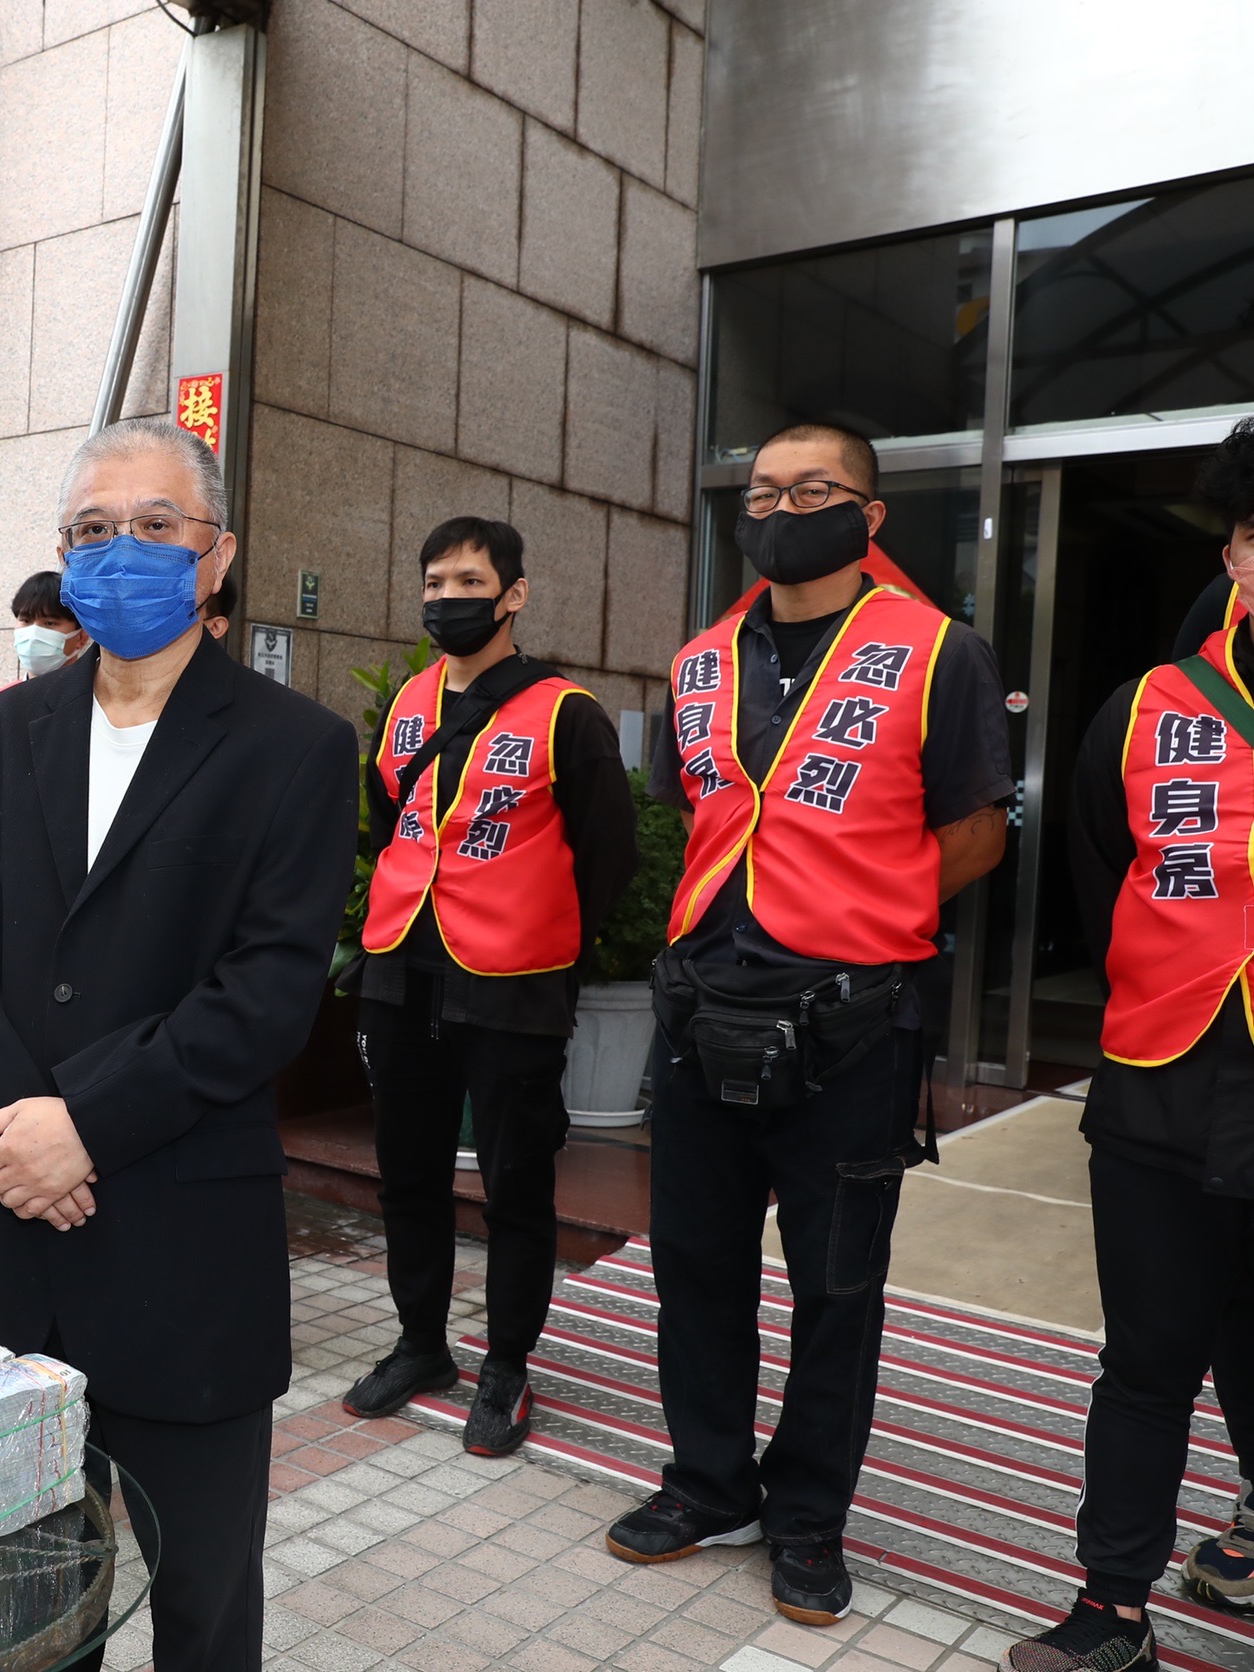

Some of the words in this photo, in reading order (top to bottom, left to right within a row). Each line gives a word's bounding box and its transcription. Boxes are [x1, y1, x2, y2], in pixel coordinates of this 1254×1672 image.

[457, 731, 535, 862] 忽必烈
[783, 641, 914, 815] 忽必烈
[1148, 710, 1228, 900] 健身房
